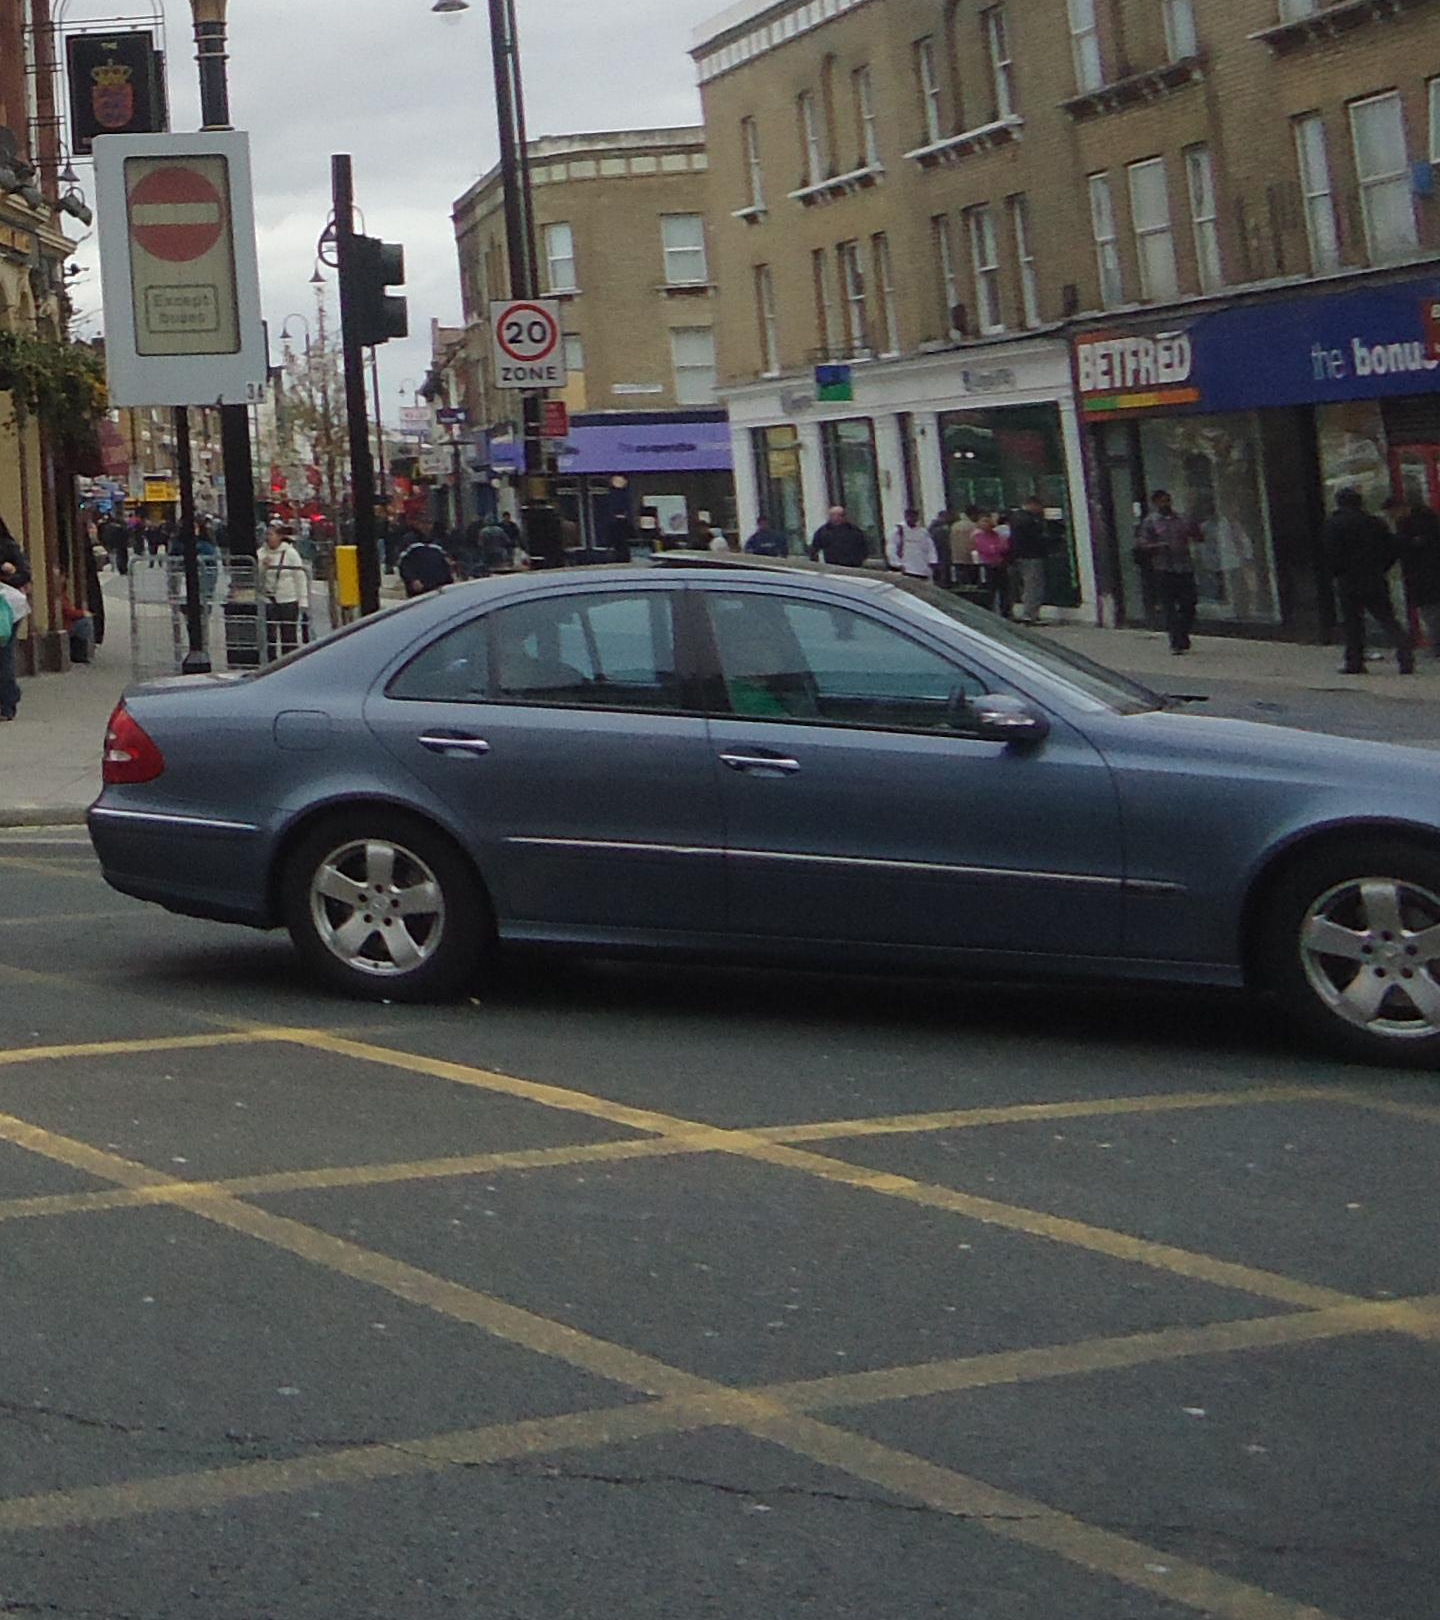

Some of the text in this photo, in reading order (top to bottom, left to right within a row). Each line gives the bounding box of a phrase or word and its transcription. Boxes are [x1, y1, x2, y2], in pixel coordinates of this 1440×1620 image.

[505, 321, 547, 345] 20
[502, 366, 557, 381] ZONE
[1077, 333, 1192, 392] BETFRED
[1311, 342, 1345, 380] the
